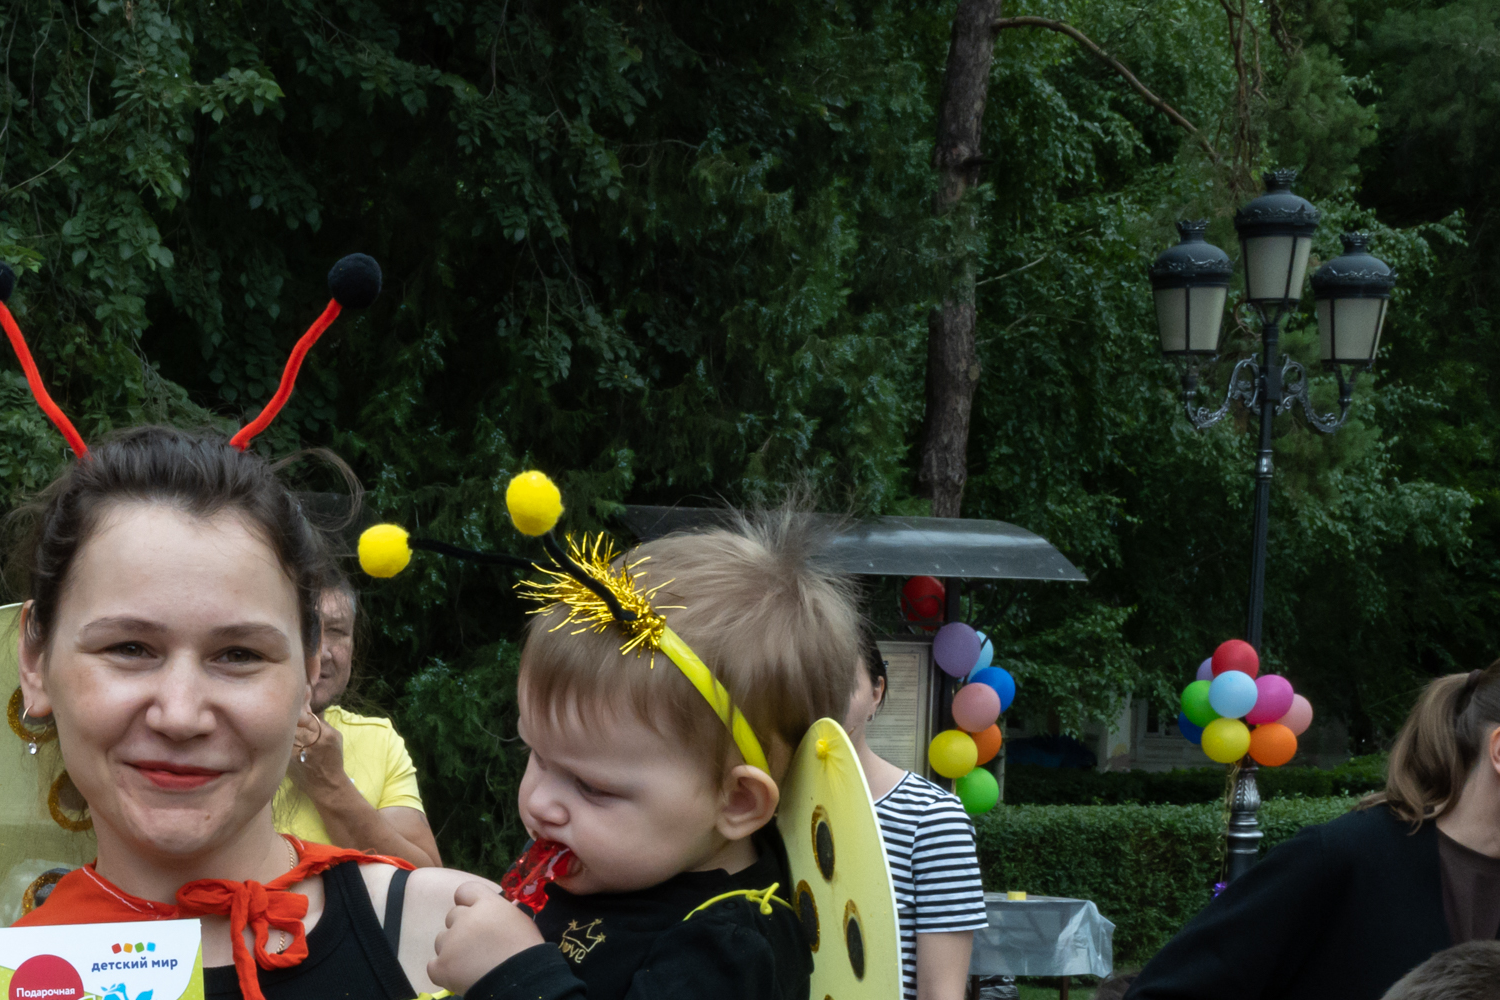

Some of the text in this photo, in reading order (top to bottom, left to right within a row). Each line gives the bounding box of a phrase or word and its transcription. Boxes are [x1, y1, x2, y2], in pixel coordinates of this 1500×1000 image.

[91, 956, 179, 973] детский мир
[16, 986, 76, 998] Подарочная
